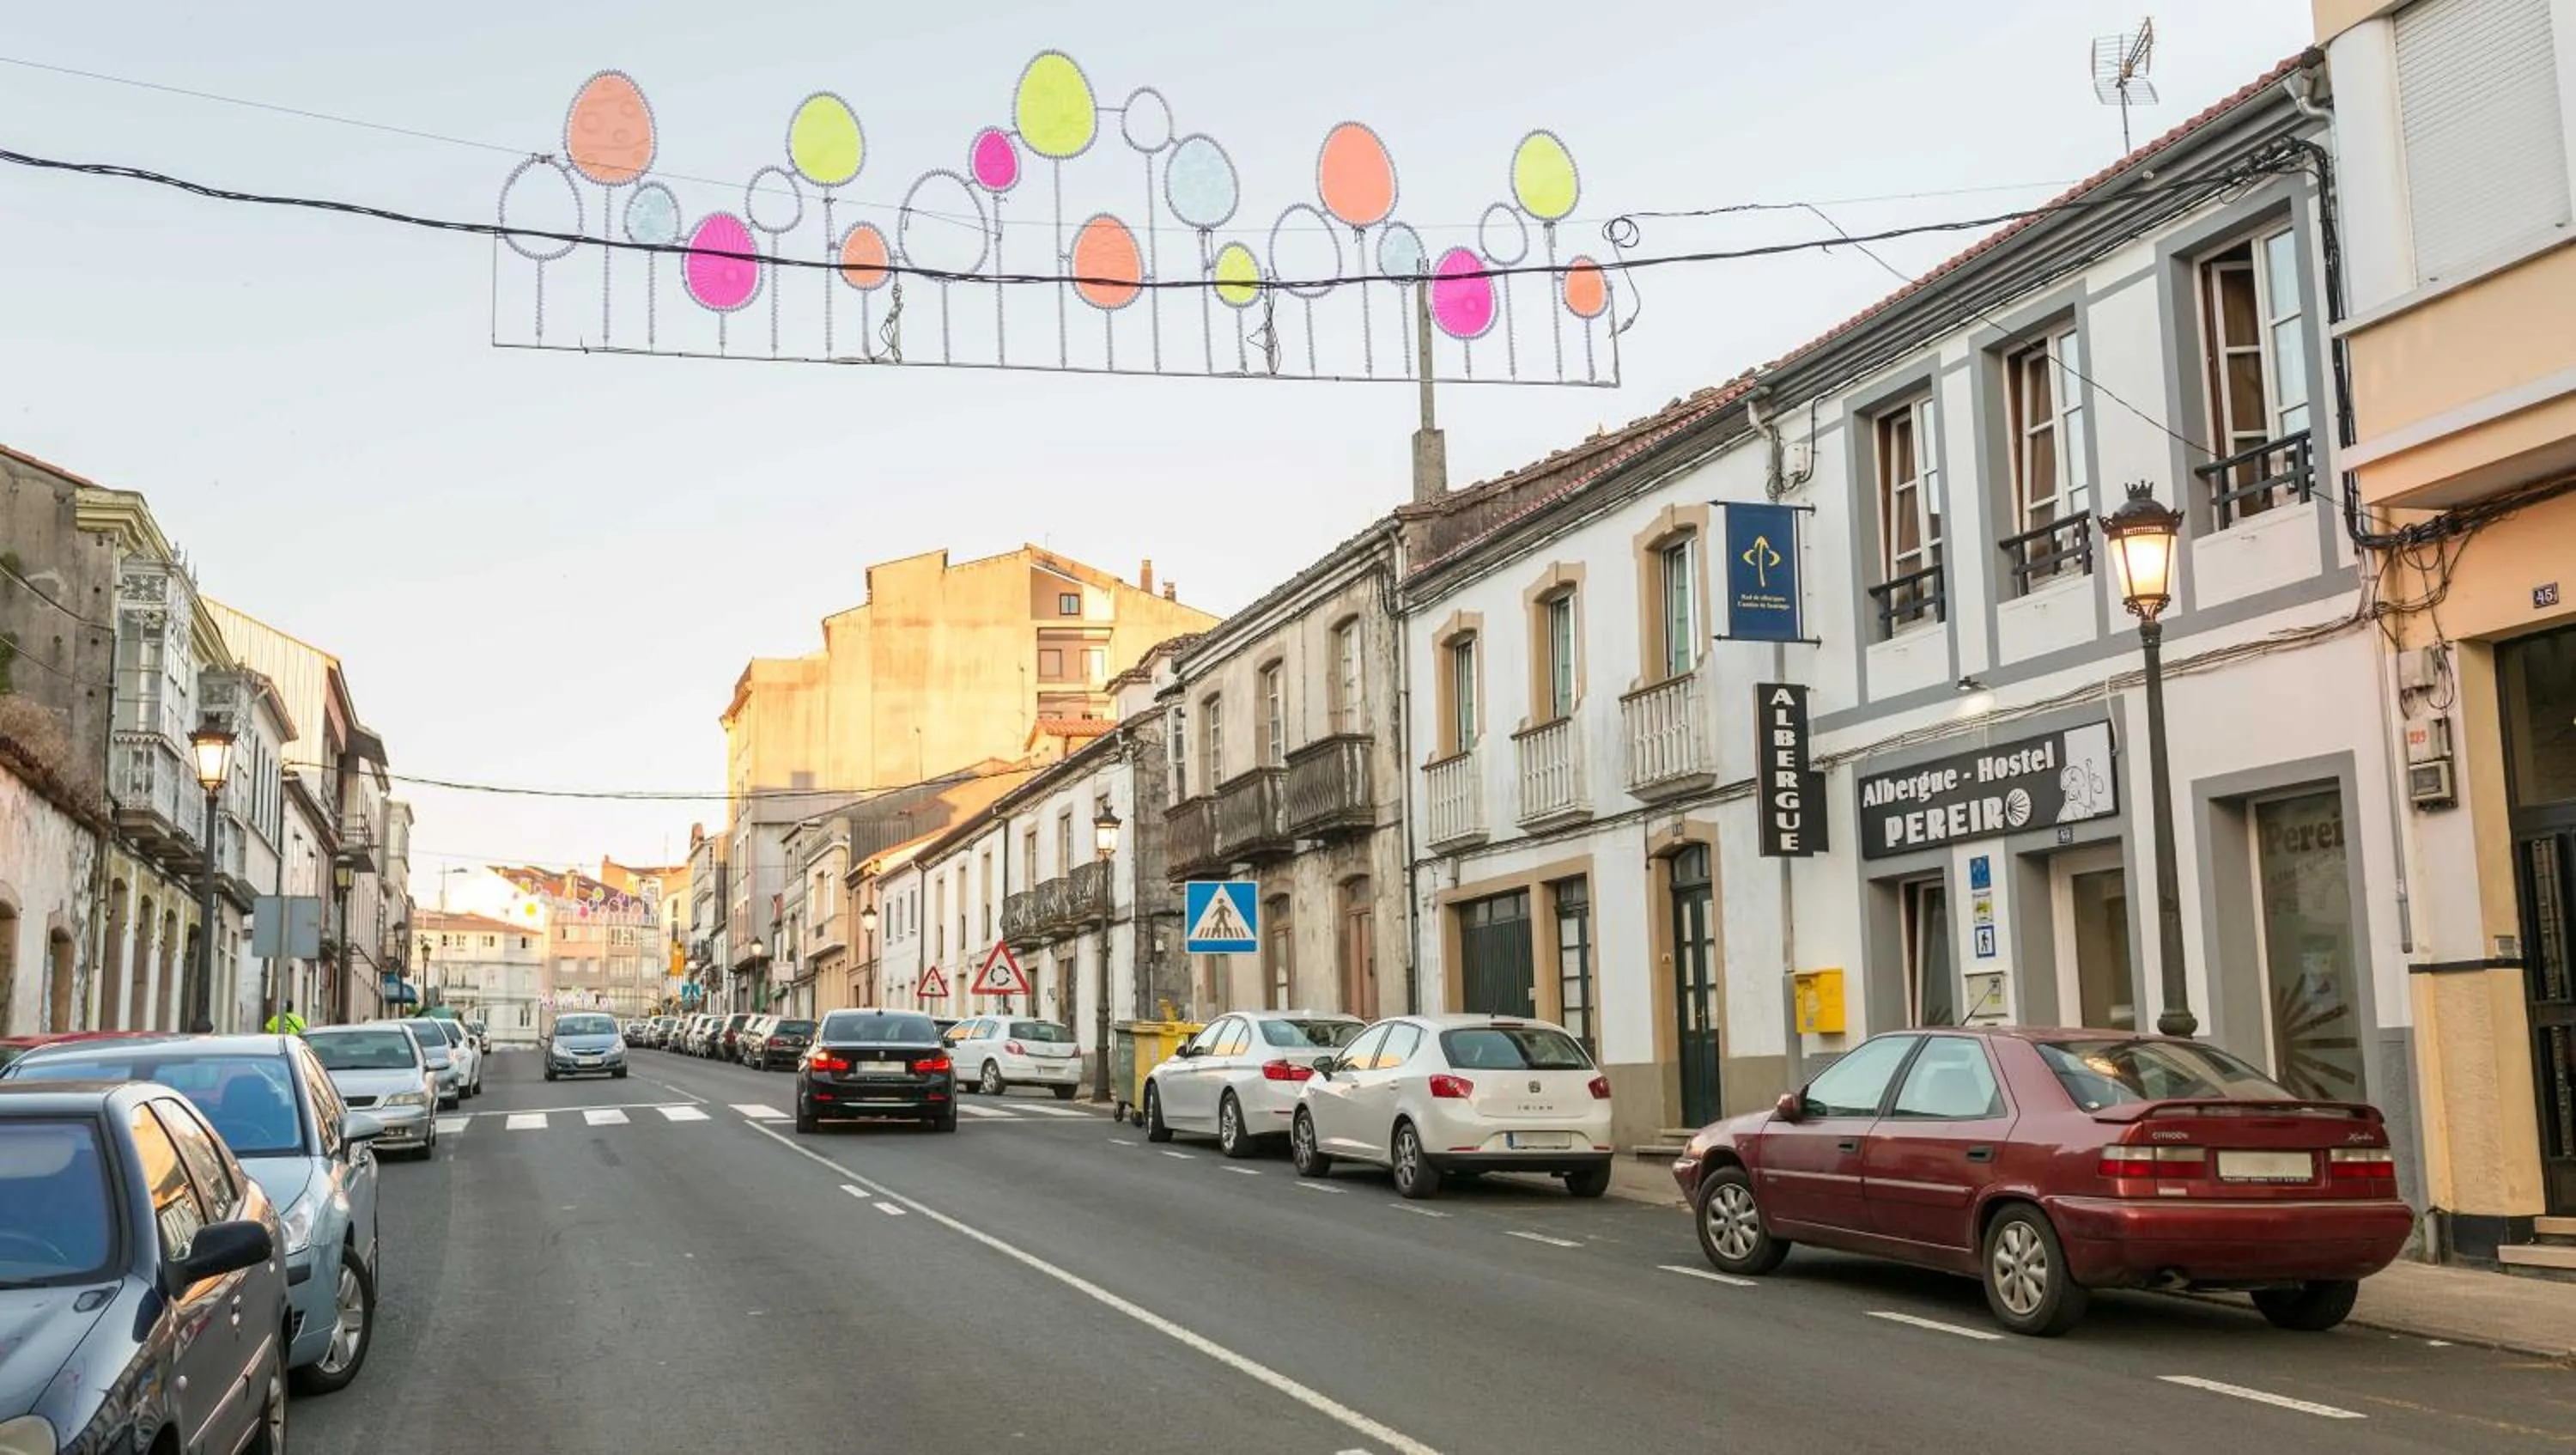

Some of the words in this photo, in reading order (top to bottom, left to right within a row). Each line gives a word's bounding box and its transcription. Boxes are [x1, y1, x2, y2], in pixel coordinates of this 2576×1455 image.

[2536, 588, 2553, 605] 45
[1771, 688, 1801, 851] ALBERGUE
[1862, 768, 1958, 808] Albergue
[1978, 740, 2055, 782] Hostel
